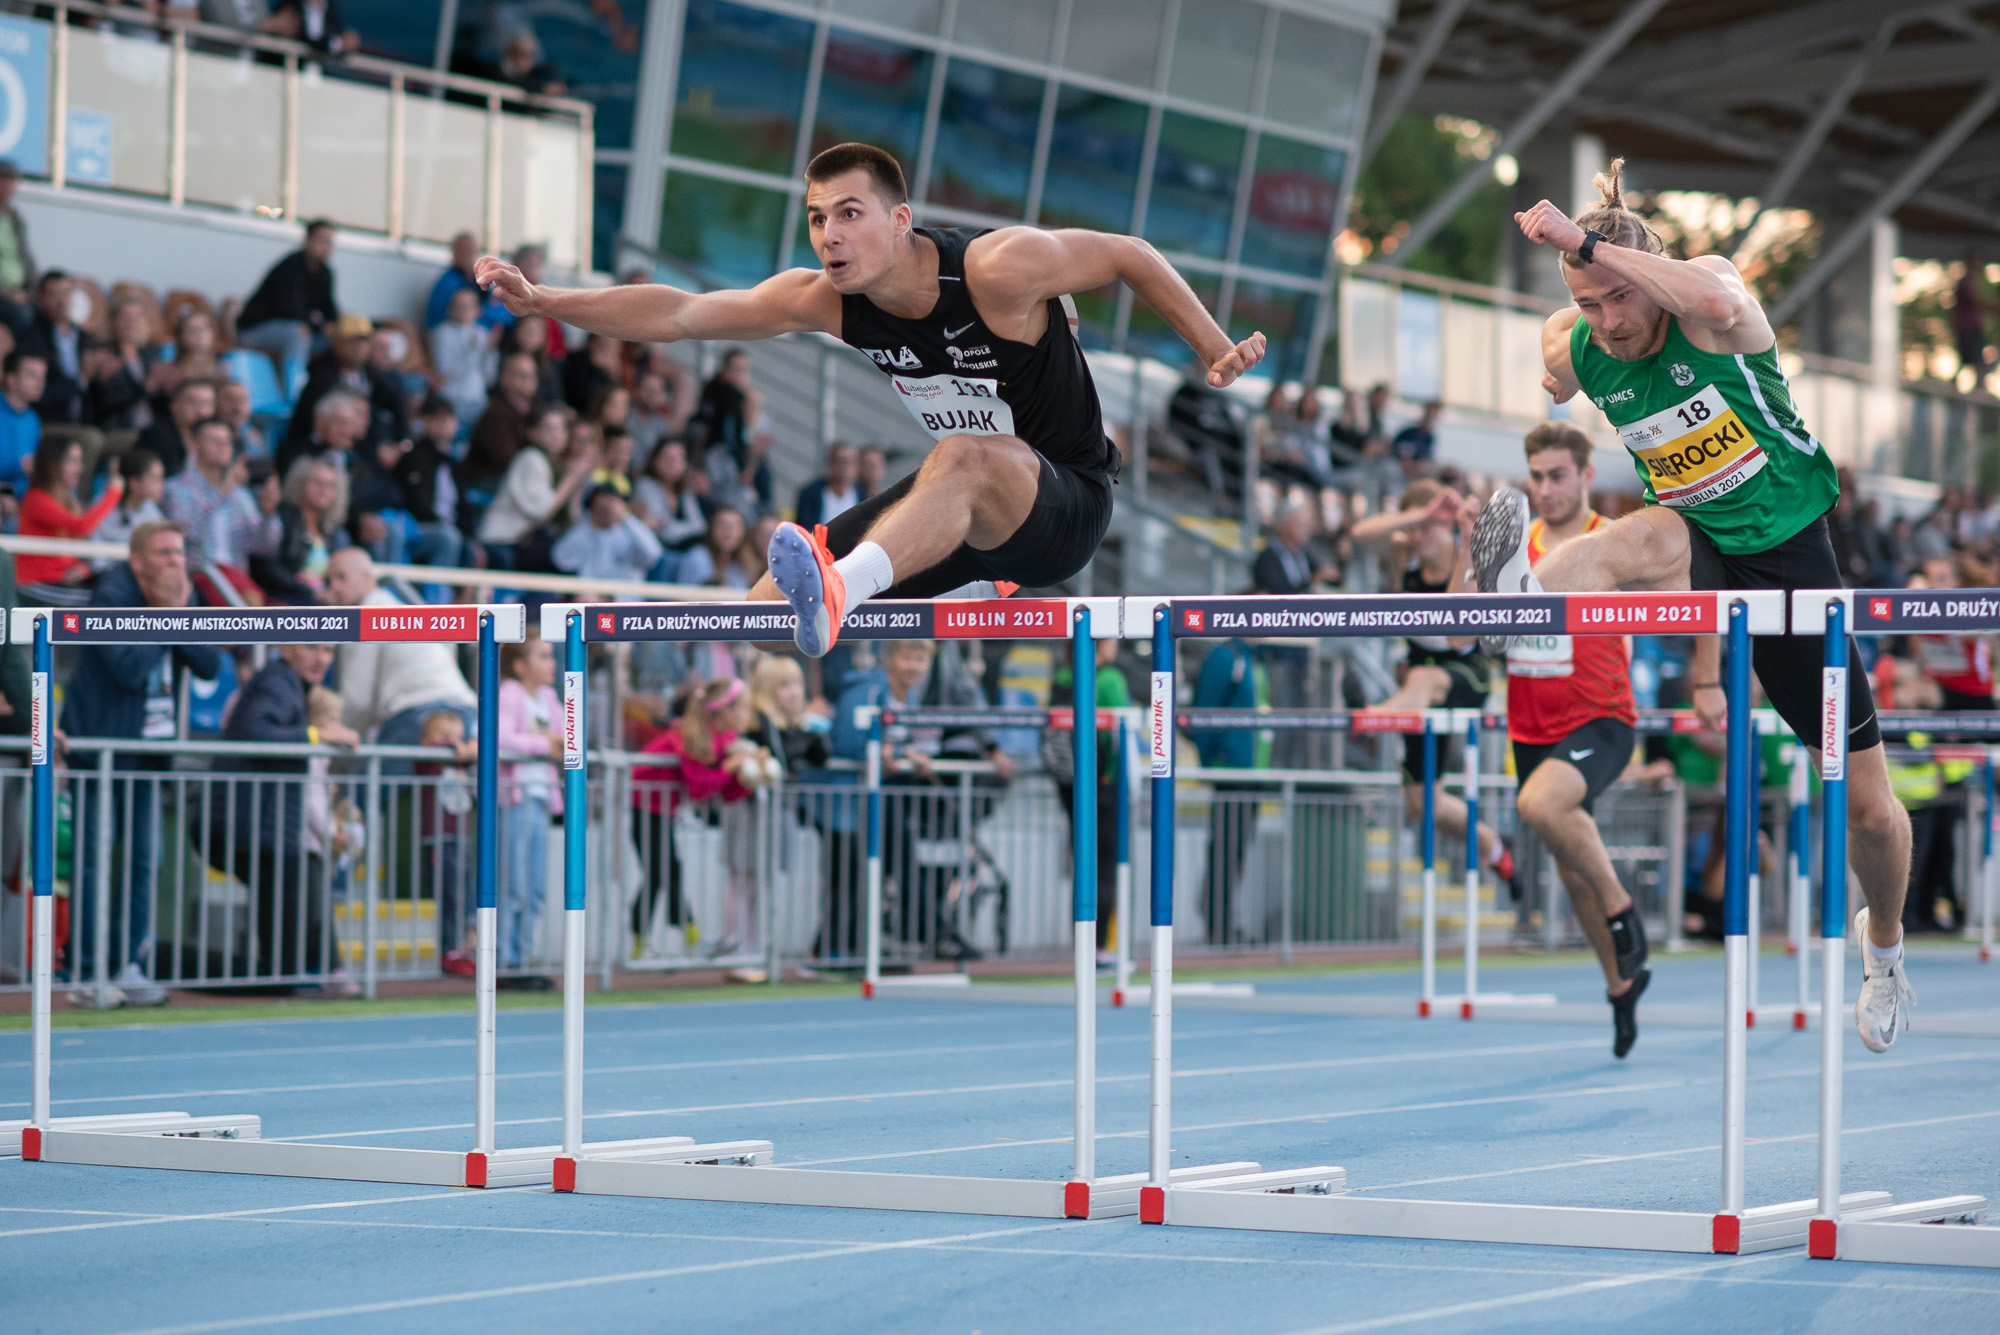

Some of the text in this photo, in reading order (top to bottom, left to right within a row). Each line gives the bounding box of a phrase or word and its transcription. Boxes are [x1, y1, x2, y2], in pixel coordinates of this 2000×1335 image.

[963, 346, 991, 357] OPOLE
[950, 379, 992, 398] 119
[1606, 388, 1635, 404] UMCS
[921, 410, 999, 432] BUJAK
[1676, 400, 1711, 428] 18
[1647, 420, 1746, 478] SIEROCKI
[1682, 487, 1719, 507] LUBLIN
[1718, 471, 1746, 492] 2021
[1581, 605, 1701, 623] LUBLIN 2021
[1902, 597, 2000, 617] PZLA DRUŻY
[85, 614, 349, 630] PZLA DRUŻYNOWE MISTRZOSTWA POLSKI 2021
[372, 616, 466, 630] LUBLIN 2021
[622, 613, 921, 630] PZLA DRUŻYNOWE MISTRZO POLSKI 2021
[947, 611, 1053, 627] LUBLIN 2021
[1214, 608, 1551, 628] PZLA DRUŻYNOWE MISTRZOSTWA POLSKI 2021
[32, 697, 42, 747] polanik
[565, 698, 578, 751] polanik
[1153, 700, 1166, 757] polanik
[1825, 697, 1838, 758] polanik
